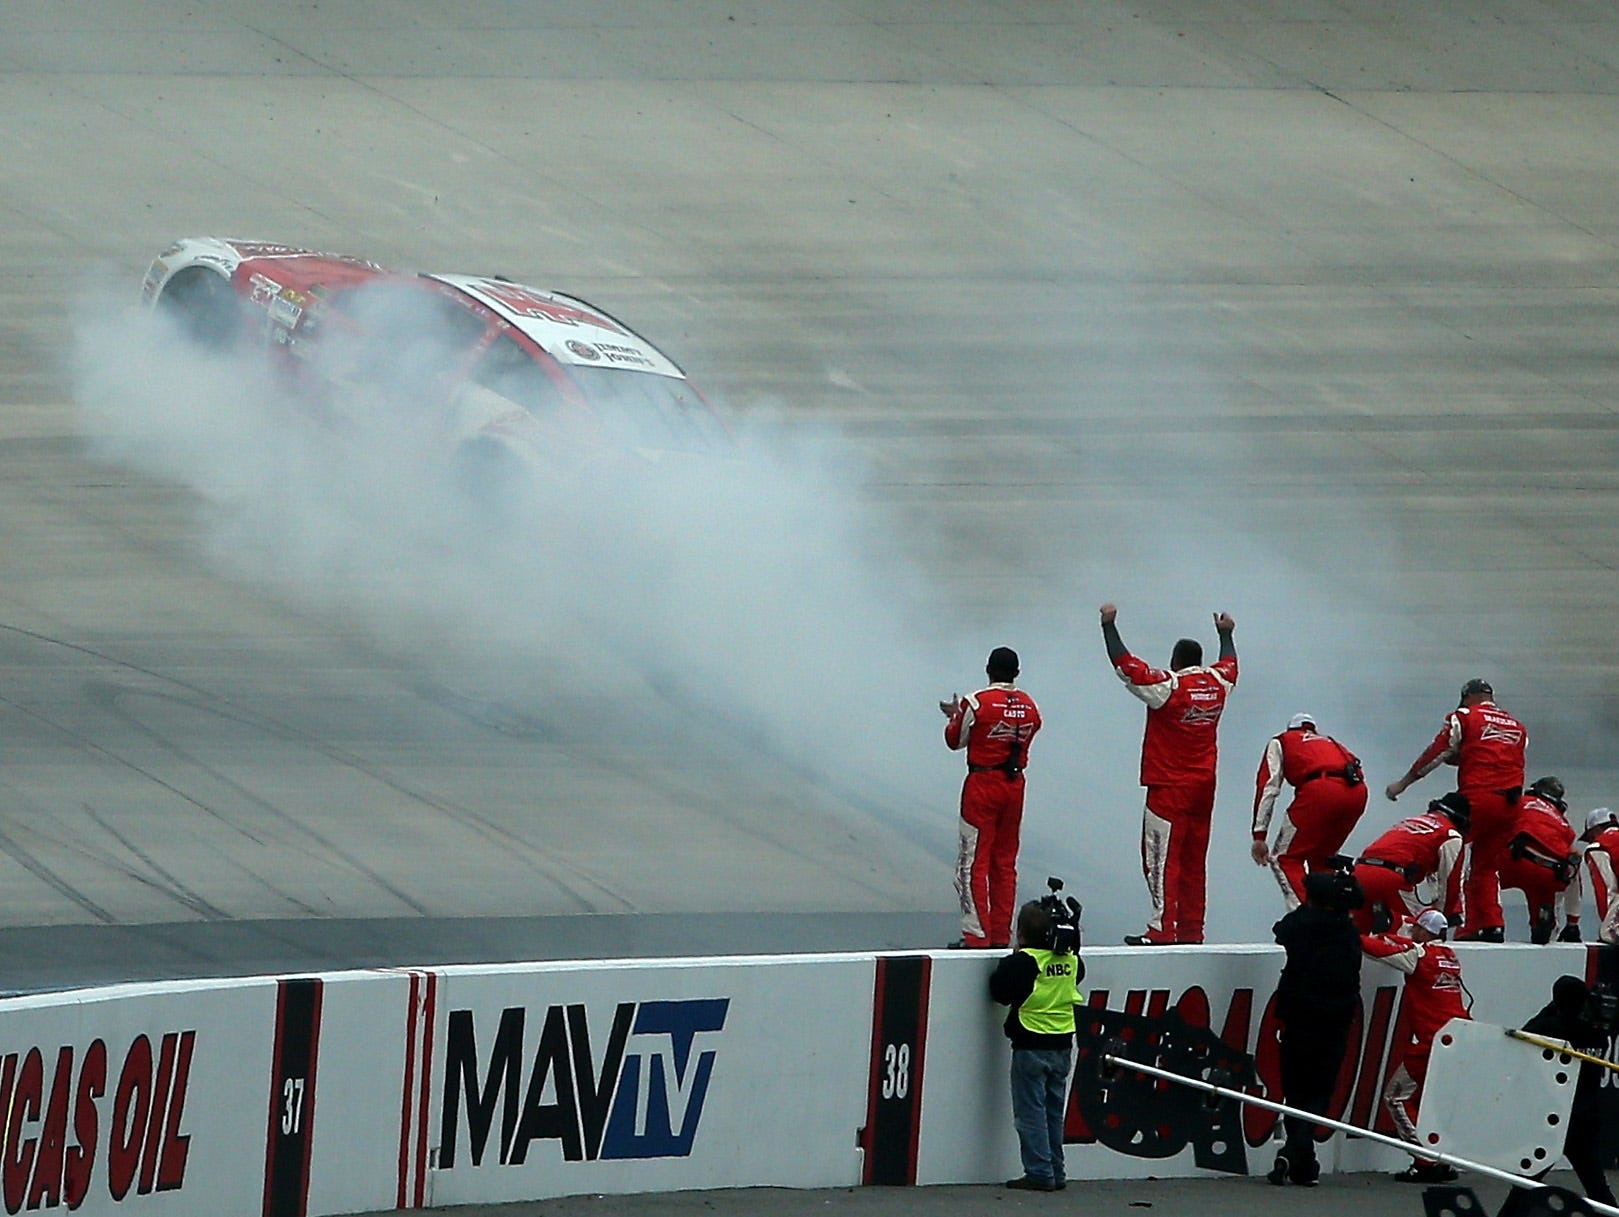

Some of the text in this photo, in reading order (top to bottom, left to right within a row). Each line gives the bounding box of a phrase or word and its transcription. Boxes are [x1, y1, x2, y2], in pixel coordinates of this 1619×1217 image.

[1046, 963, 1071, 977] NBC
[882, 1043, 910, 1100] 38
[108, 1030, 196, 1202] OIL
[282, 1078, 305, 1135] 37
